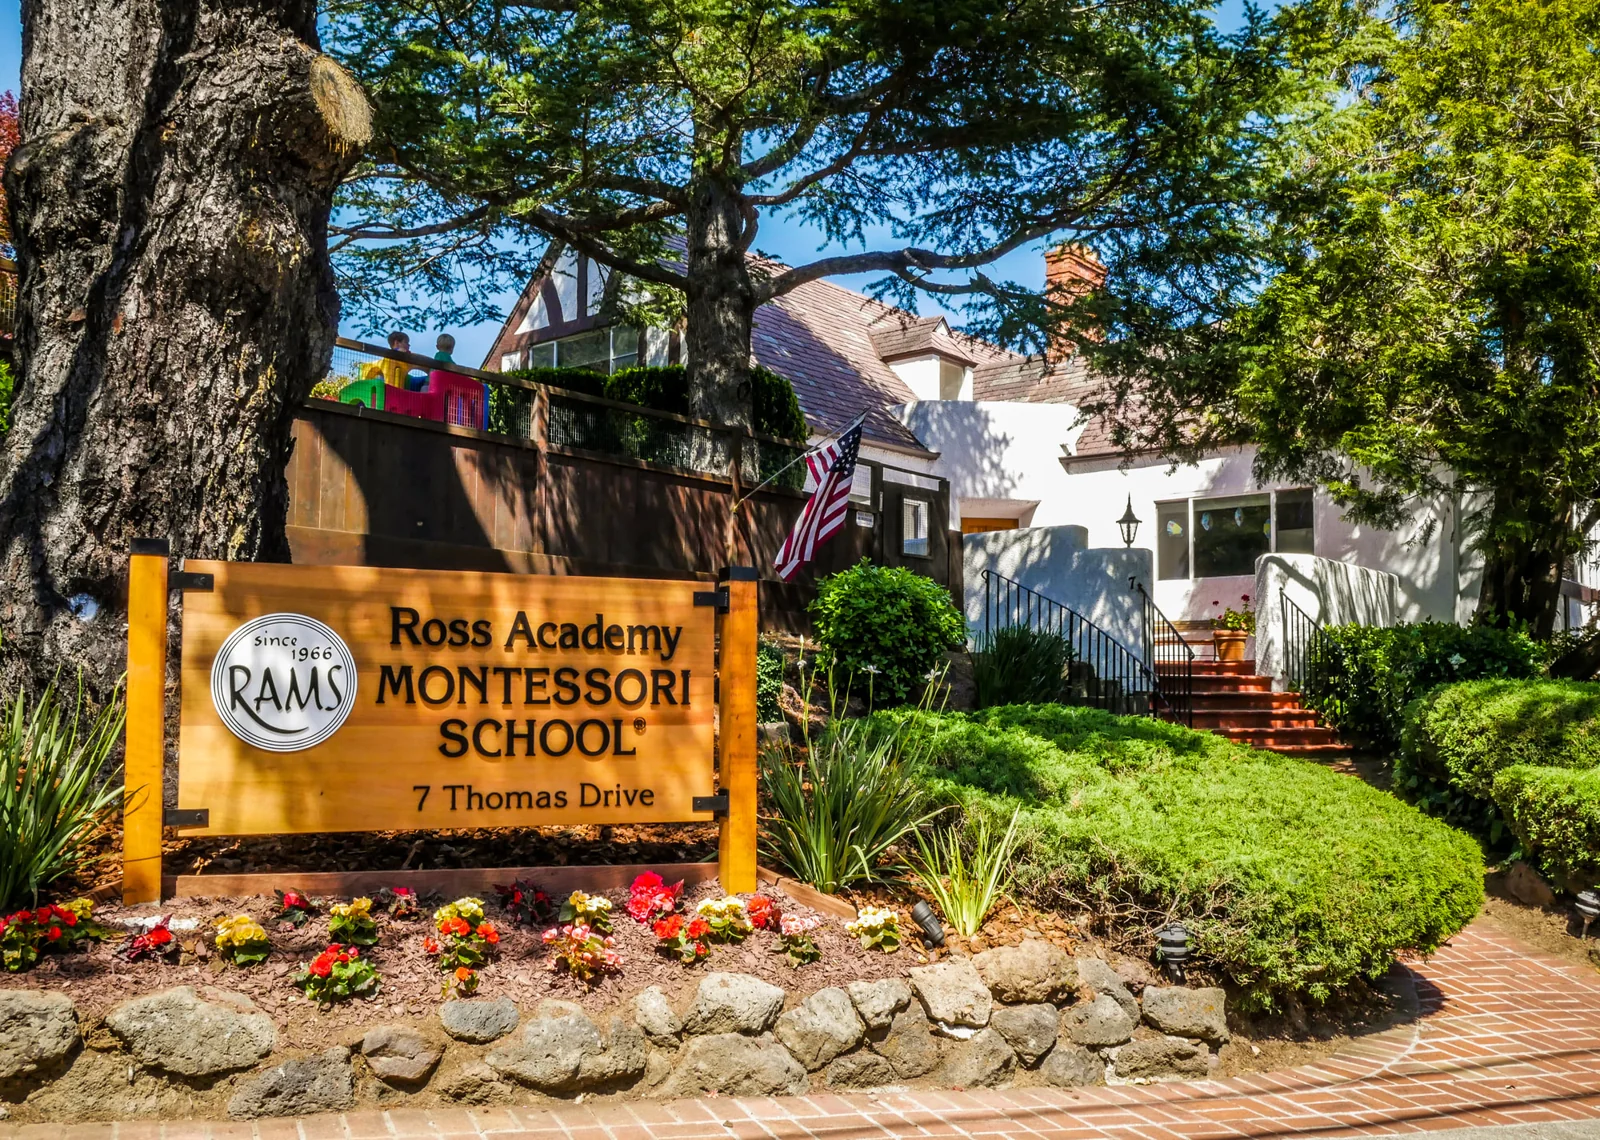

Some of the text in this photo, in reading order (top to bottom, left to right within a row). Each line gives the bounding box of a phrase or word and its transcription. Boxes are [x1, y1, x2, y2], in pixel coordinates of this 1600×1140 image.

[1128, 576, 1136, 590] 7
[254, 630, 297, 647] since
[389, 606, 682, 661] Ross Academy
[291, 646, 332, 662] 1966
[228, 664, 343, 734] RAMS
[375, 665, 691, 706] MONTESSORI
[413, 782, 655, 811] 7 Thomas Drive
